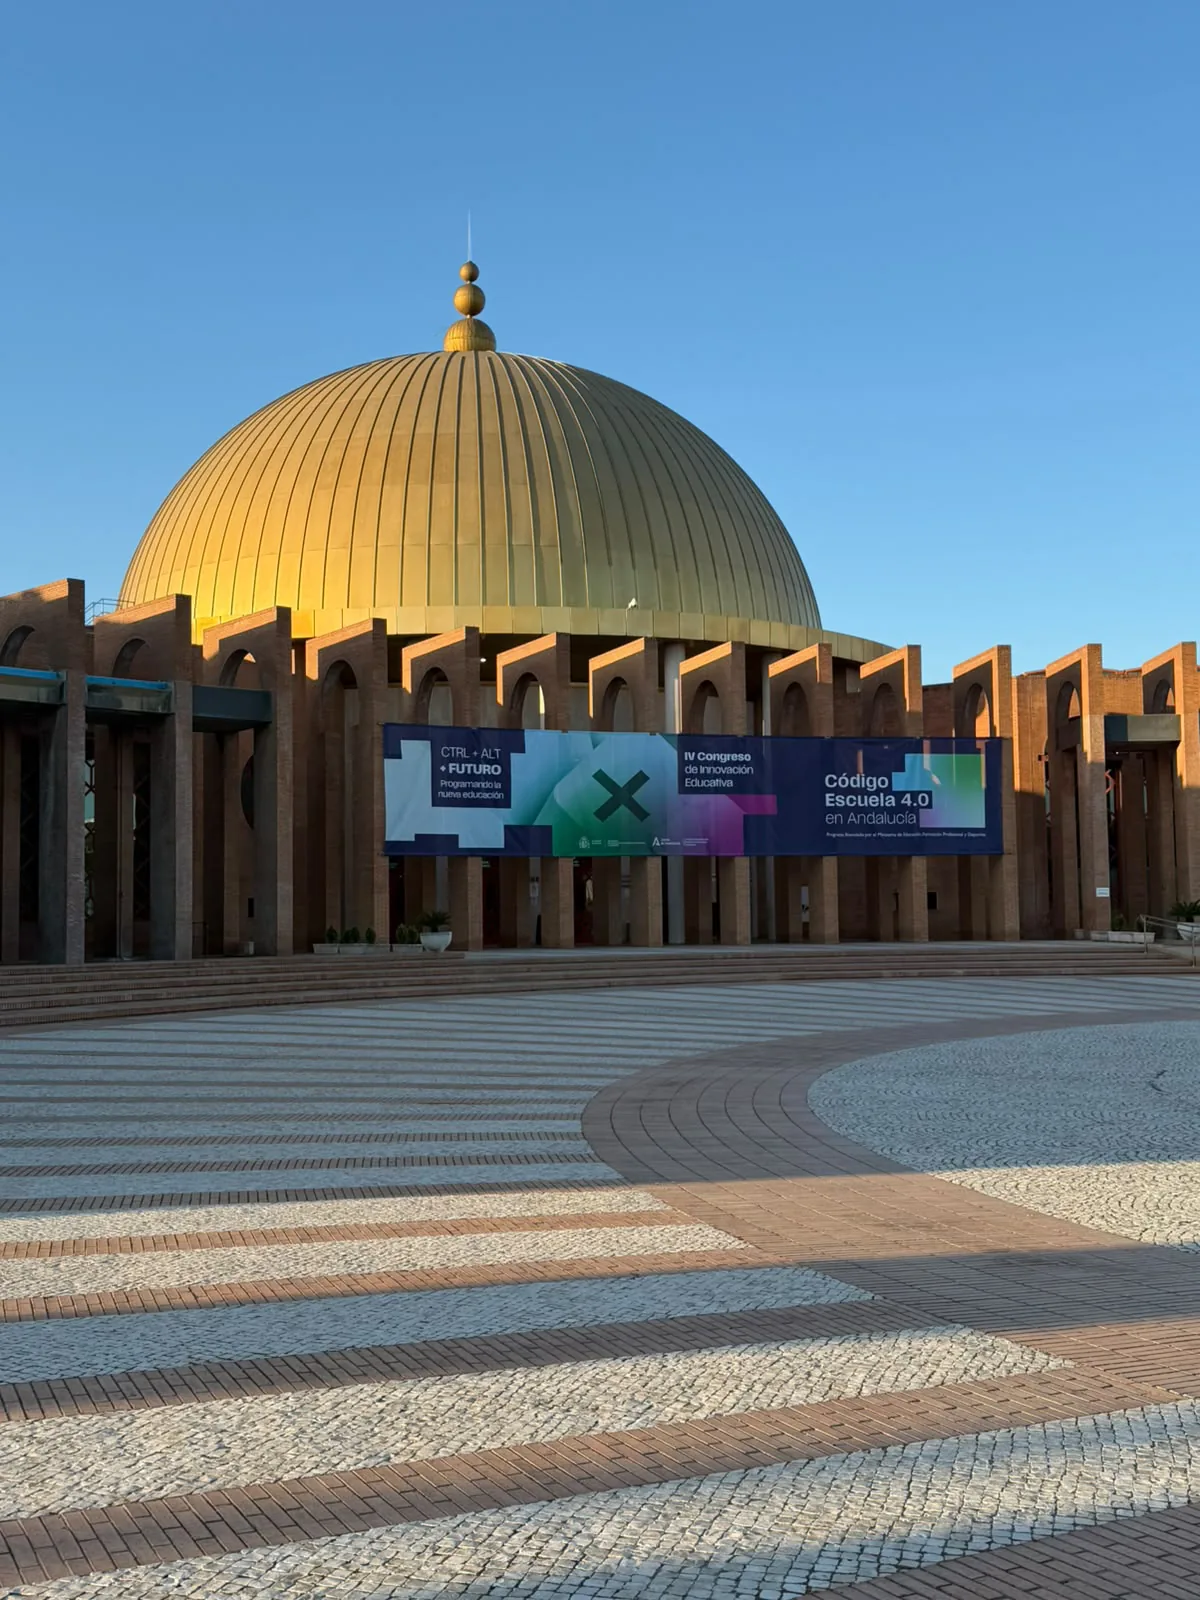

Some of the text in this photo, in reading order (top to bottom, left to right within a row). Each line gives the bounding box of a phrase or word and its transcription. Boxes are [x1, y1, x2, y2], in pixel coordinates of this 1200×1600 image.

[440, 746, 471, 759] CTRL
[480, 748, 502, 759] ALT
[684, 752, 752, 763] IV Congreso
[448, 763, 502, 775] FUTURO
[684, 764, 754, 775] de Innovación
[440, 780, 502, 790] Programando la
[685, 777, 734, 788] Educativa
[825, 772, 889, 792] Código
[438, 791, 505, 800] nueva educación
[825, 792, 930, 807] Escuela 4.0
[825, 811, 917, 825] en Andalucía
